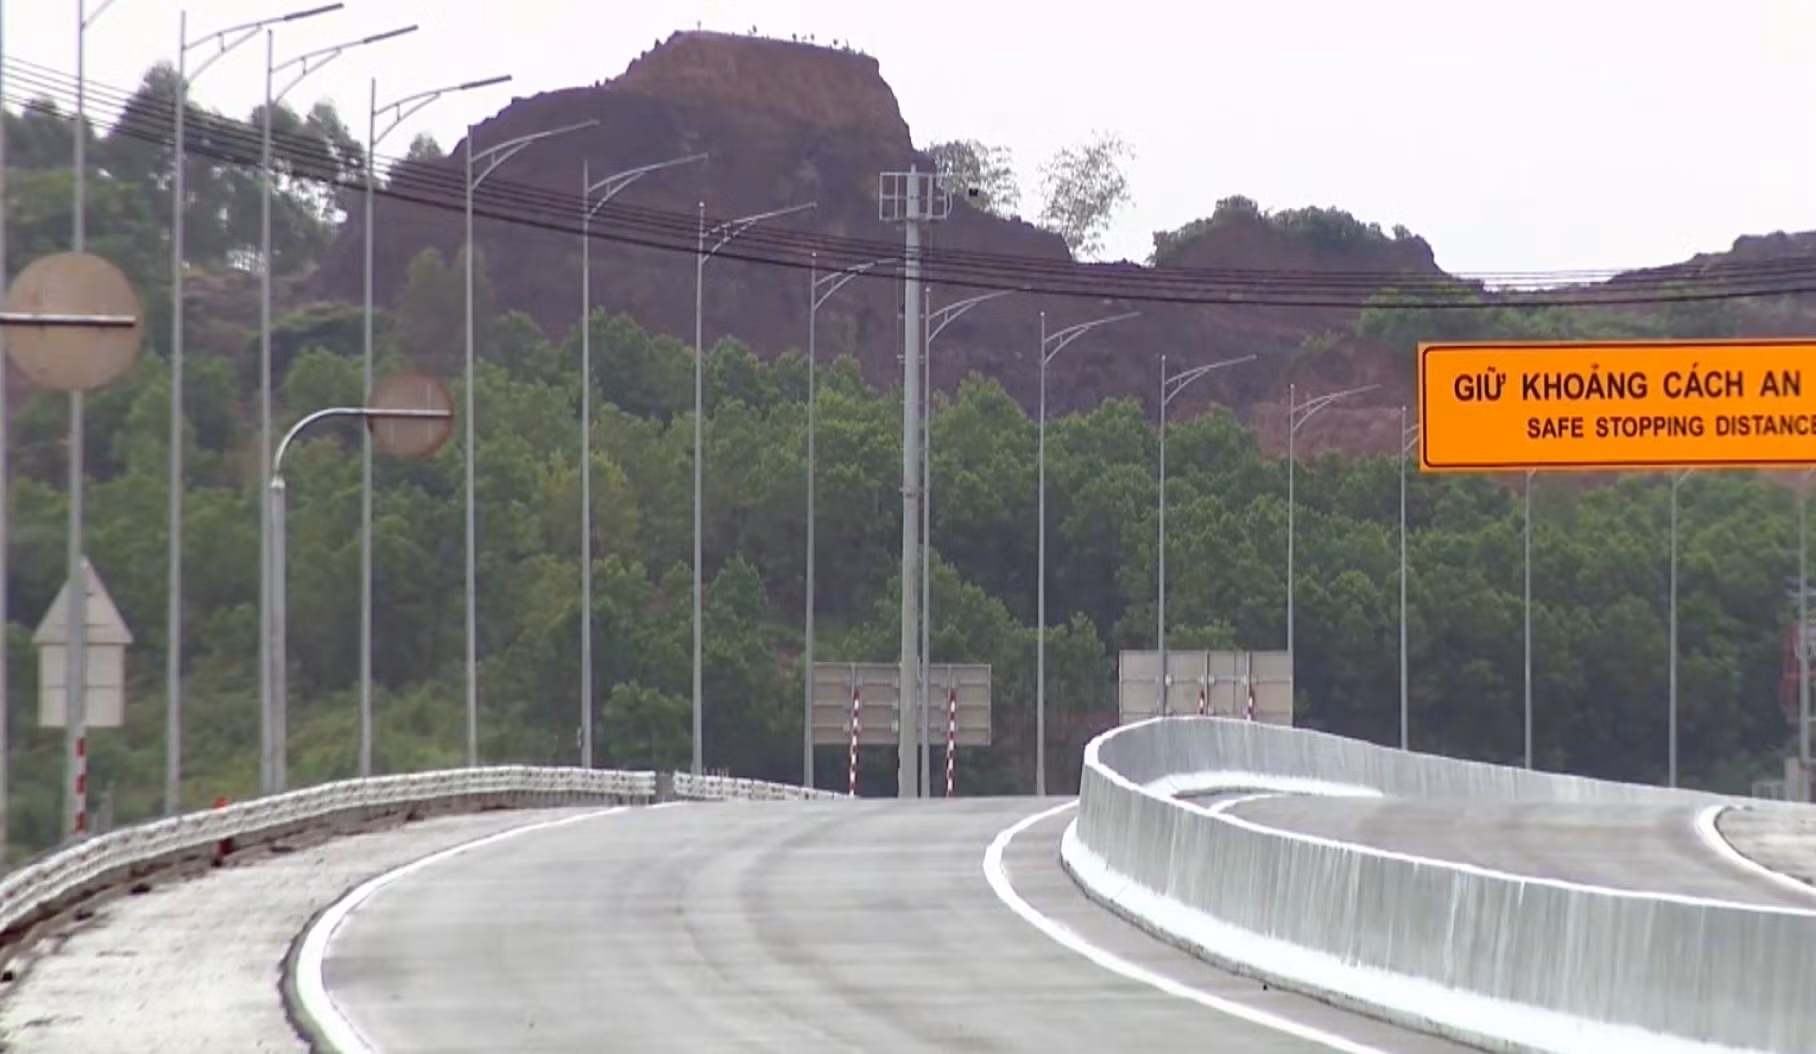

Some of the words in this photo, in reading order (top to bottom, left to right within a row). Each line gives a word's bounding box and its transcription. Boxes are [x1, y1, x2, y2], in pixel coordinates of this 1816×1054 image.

[1454, 366, 1507, 401] GIỮ
[1522, 363, 1648, 400] KHOẢNG
[1663, 361, 1744, 399] CÁCH
[1760, 370, 1801, 398] AN
[1527, 417, 1584, 439] SAFE
[1595, 416, 1704, 438] STOPPING
